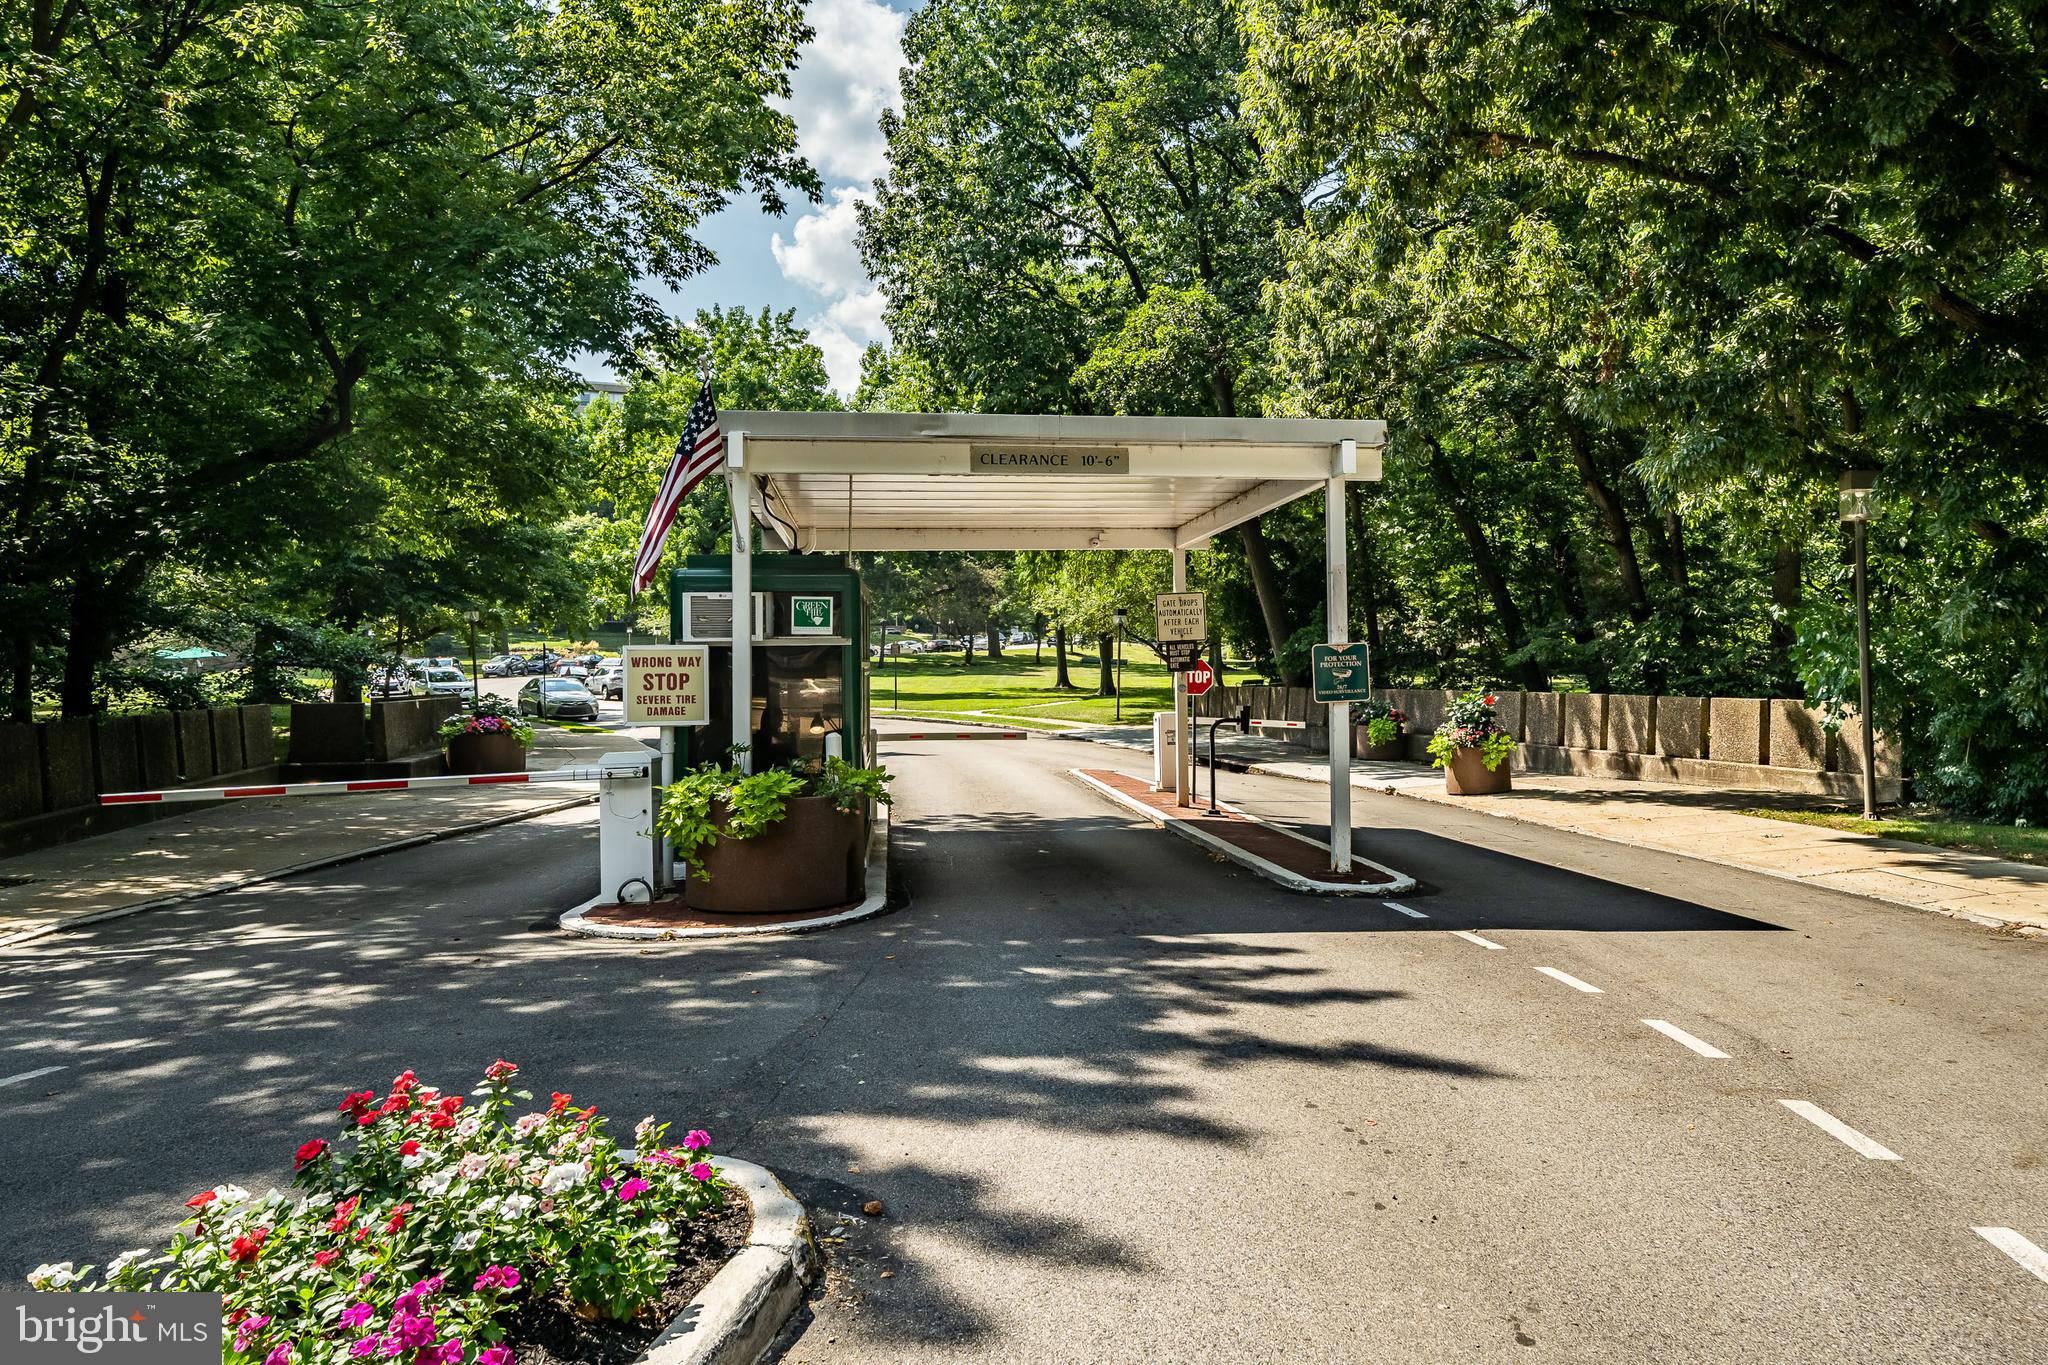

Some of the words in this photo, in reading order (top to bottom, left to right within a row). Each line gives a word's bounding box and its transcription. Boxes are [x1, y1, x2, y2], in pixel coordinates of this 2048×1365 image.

[980, 454, 1069, 466] CLEARANCE
[796, 601, 829, 611] GREEN
[1180, 599, 1198, 607] DROPS
[1164, 618, 1181, 626] AFTER
[631, 656, 672, 668] WRONG
[677, 656, 701, 667] WAY
[1320, 660, 1362, 668] PROTECTION
[1187, 670, 1211, 683] TOP
[643, 673, 690, 691] STOP
[636, 695, 672, 705] SEVERE
[676, 694, 697, 704] TIRE
[647, 706, 687, 716] DAMAGE
